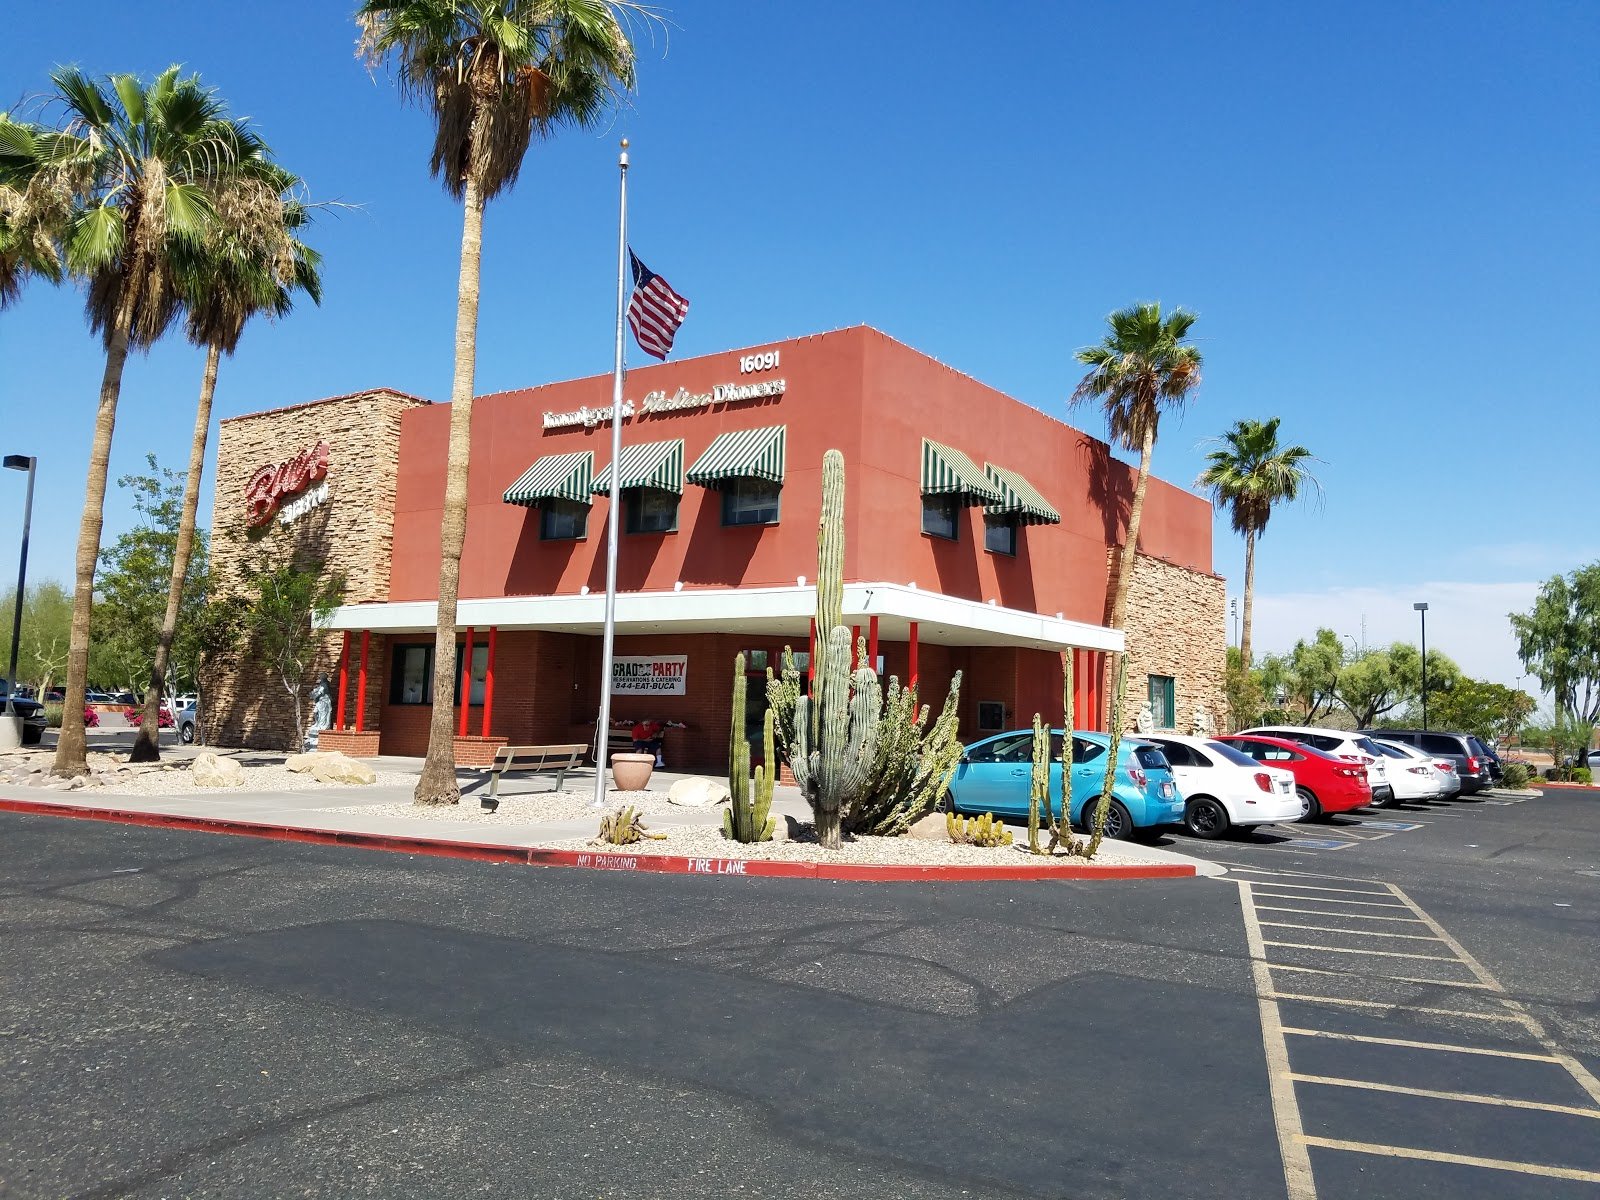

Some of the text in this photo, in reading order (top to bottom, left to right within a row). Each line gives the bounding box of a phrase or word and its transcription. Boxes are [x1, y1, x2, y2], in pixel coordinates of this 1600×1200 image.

[739, 350, 781, 374] 16091
[542, 399, 636, 428] Immigrat
[712, 379, 786, 404] Dinners
[652, 662, 686, 677] PARTY
[615, 682, 675, 690] 844-EAT-BUCA
[577, 854, 748, 874] NO PARKING FIRE LANE
